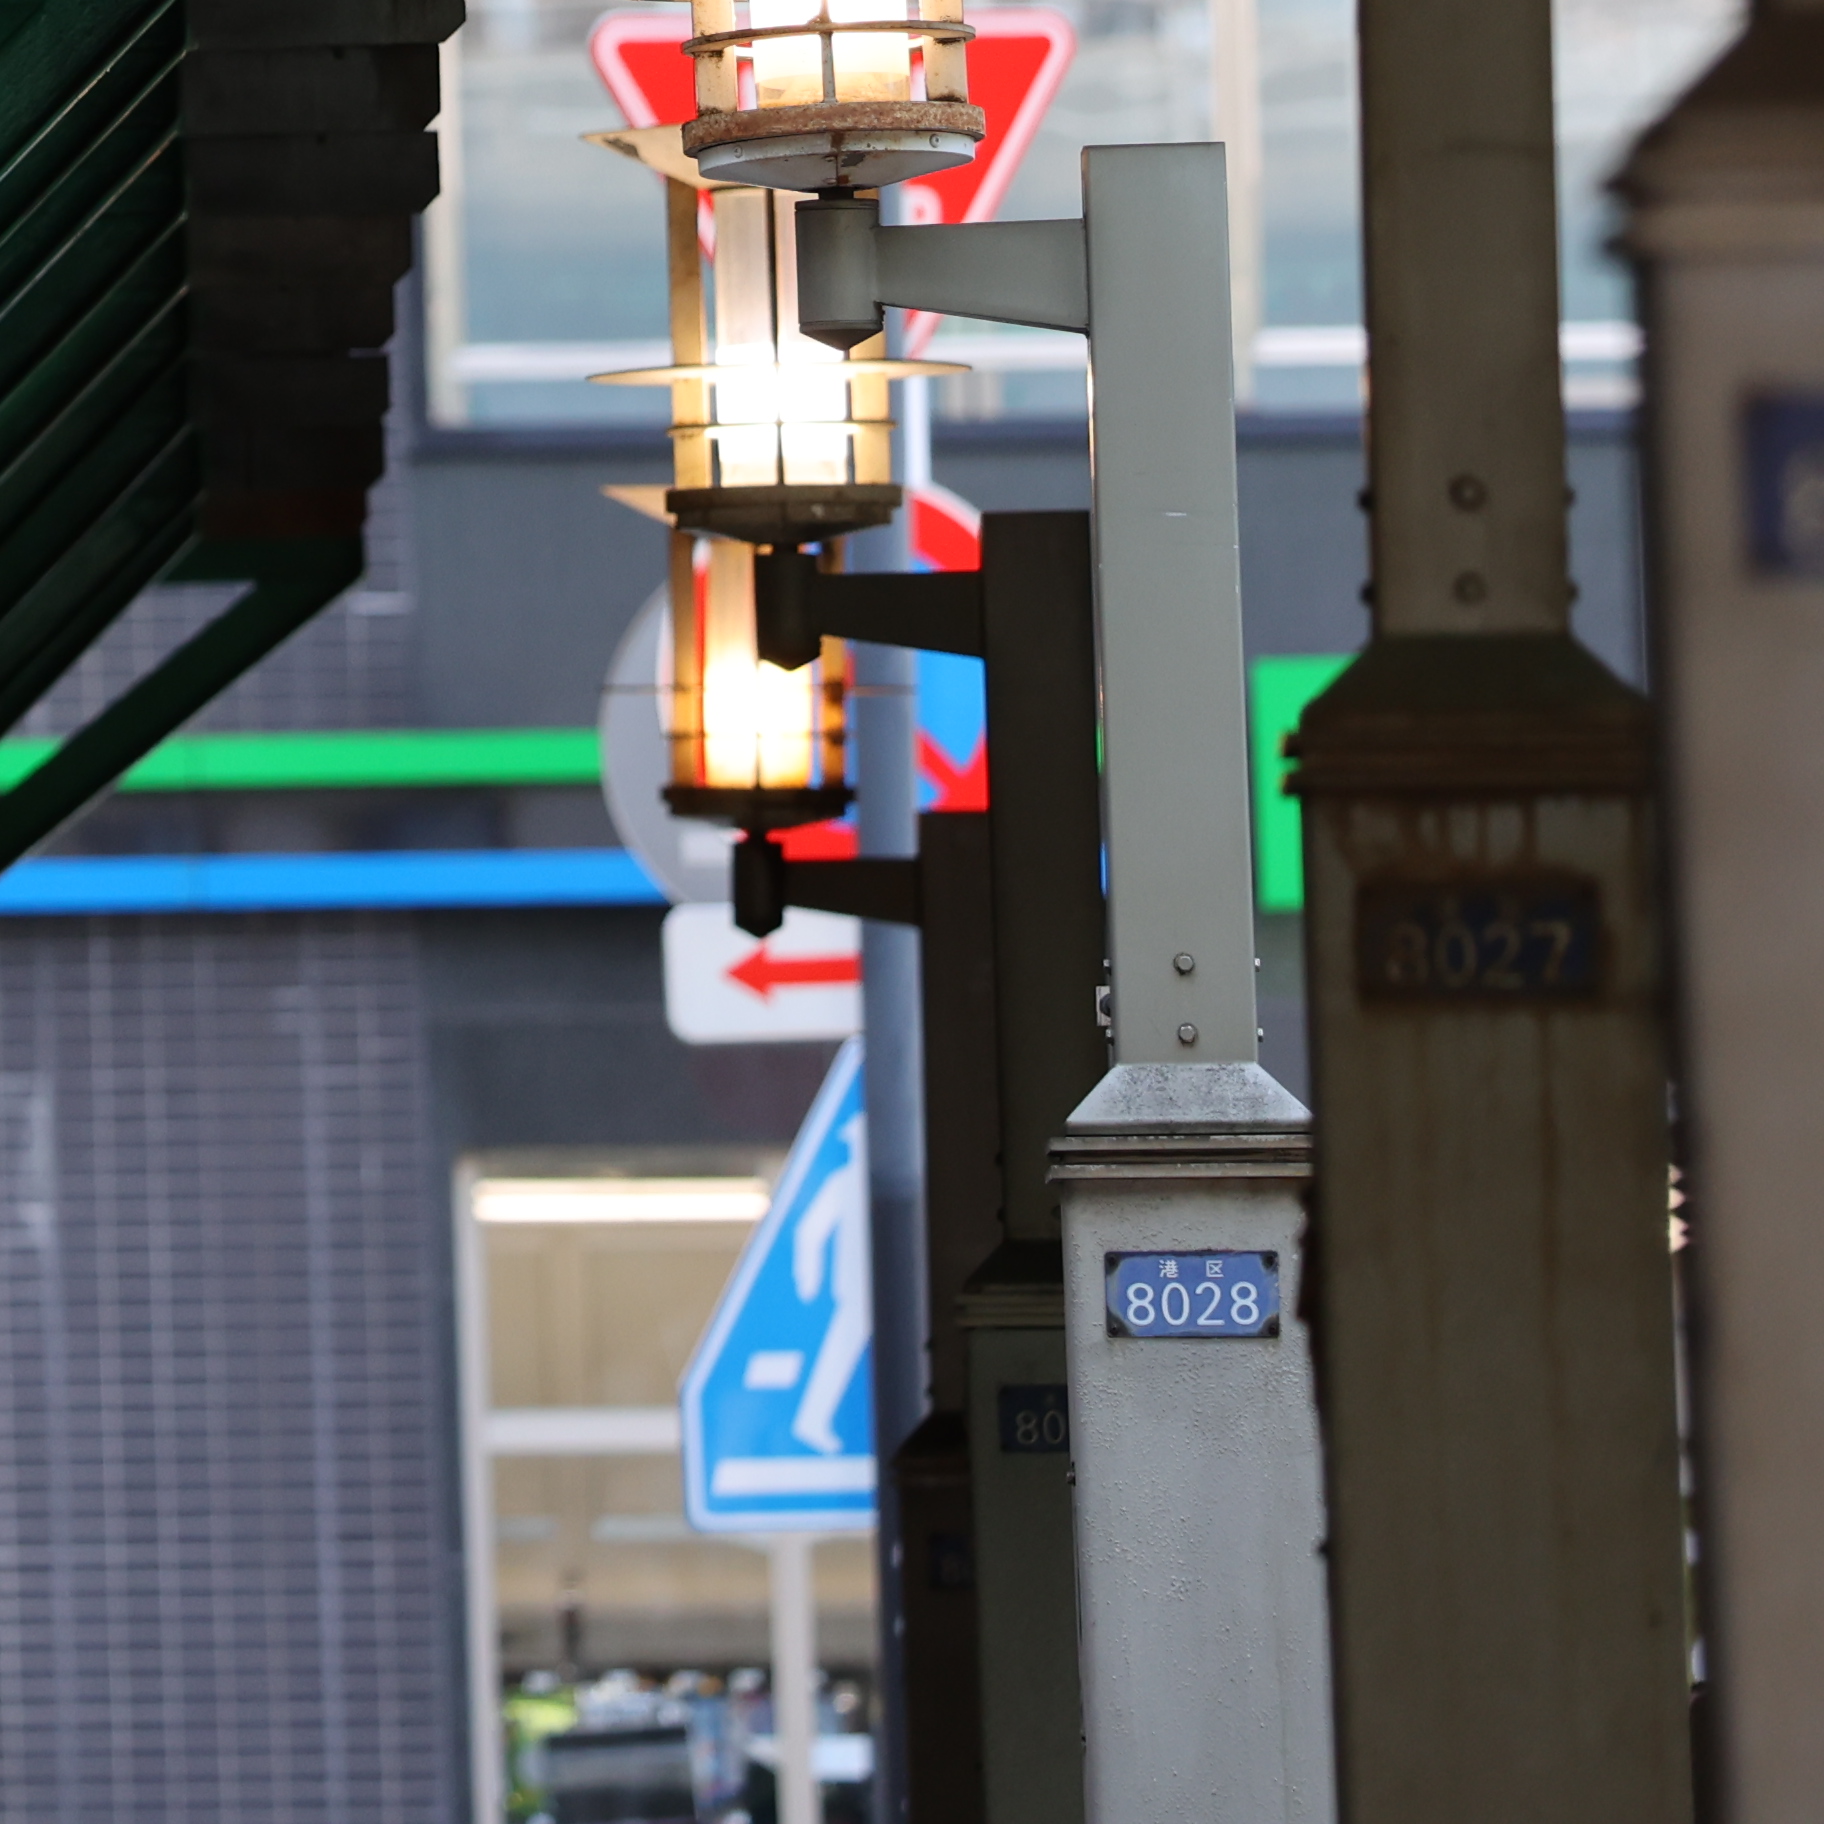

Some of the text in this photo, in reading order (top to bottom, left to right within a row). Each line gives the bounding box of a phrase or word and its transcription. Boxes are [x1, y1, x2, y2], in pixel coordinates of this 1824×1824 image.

[1158, 1259, 1225, 1278] 港区
[1126, 1281, 1260, 1327] 8028
[1016, 1409, 1066, 1445] 80
